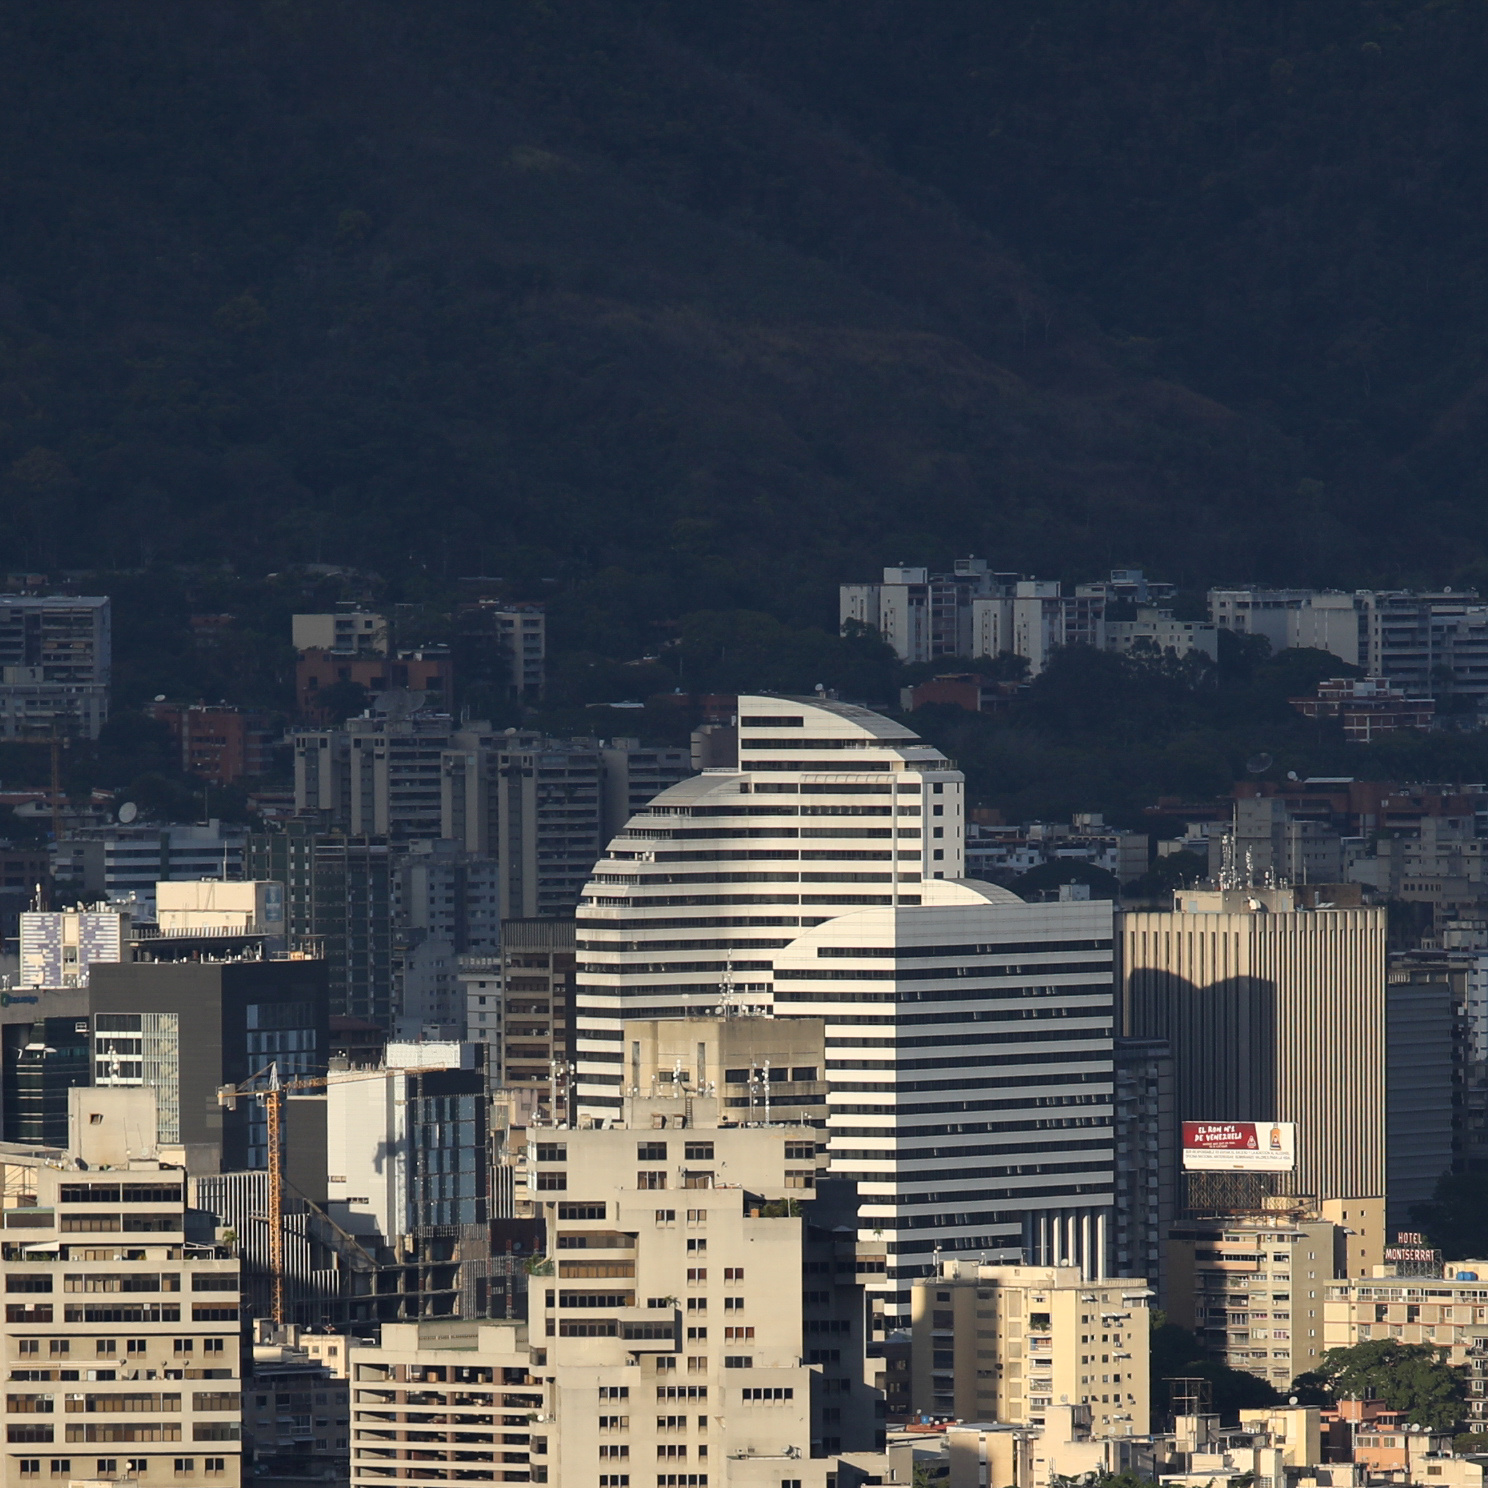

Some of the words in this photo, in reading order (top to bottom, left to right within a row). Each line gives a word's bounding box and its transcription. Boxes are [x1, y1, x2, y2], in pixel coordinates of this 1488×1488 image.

[1198, 1126, 1207, 1134] EL
[1208, 1125, 1222, 1133] RON
[1194, 1134, 1204, 1142] DE
[1206, 1132, 1243, 1141] VENEZUELA
[1398, 1232, 1422, 1244] HOTEL
[1385, 1248, 1434, 1261] MONTSERRAT
